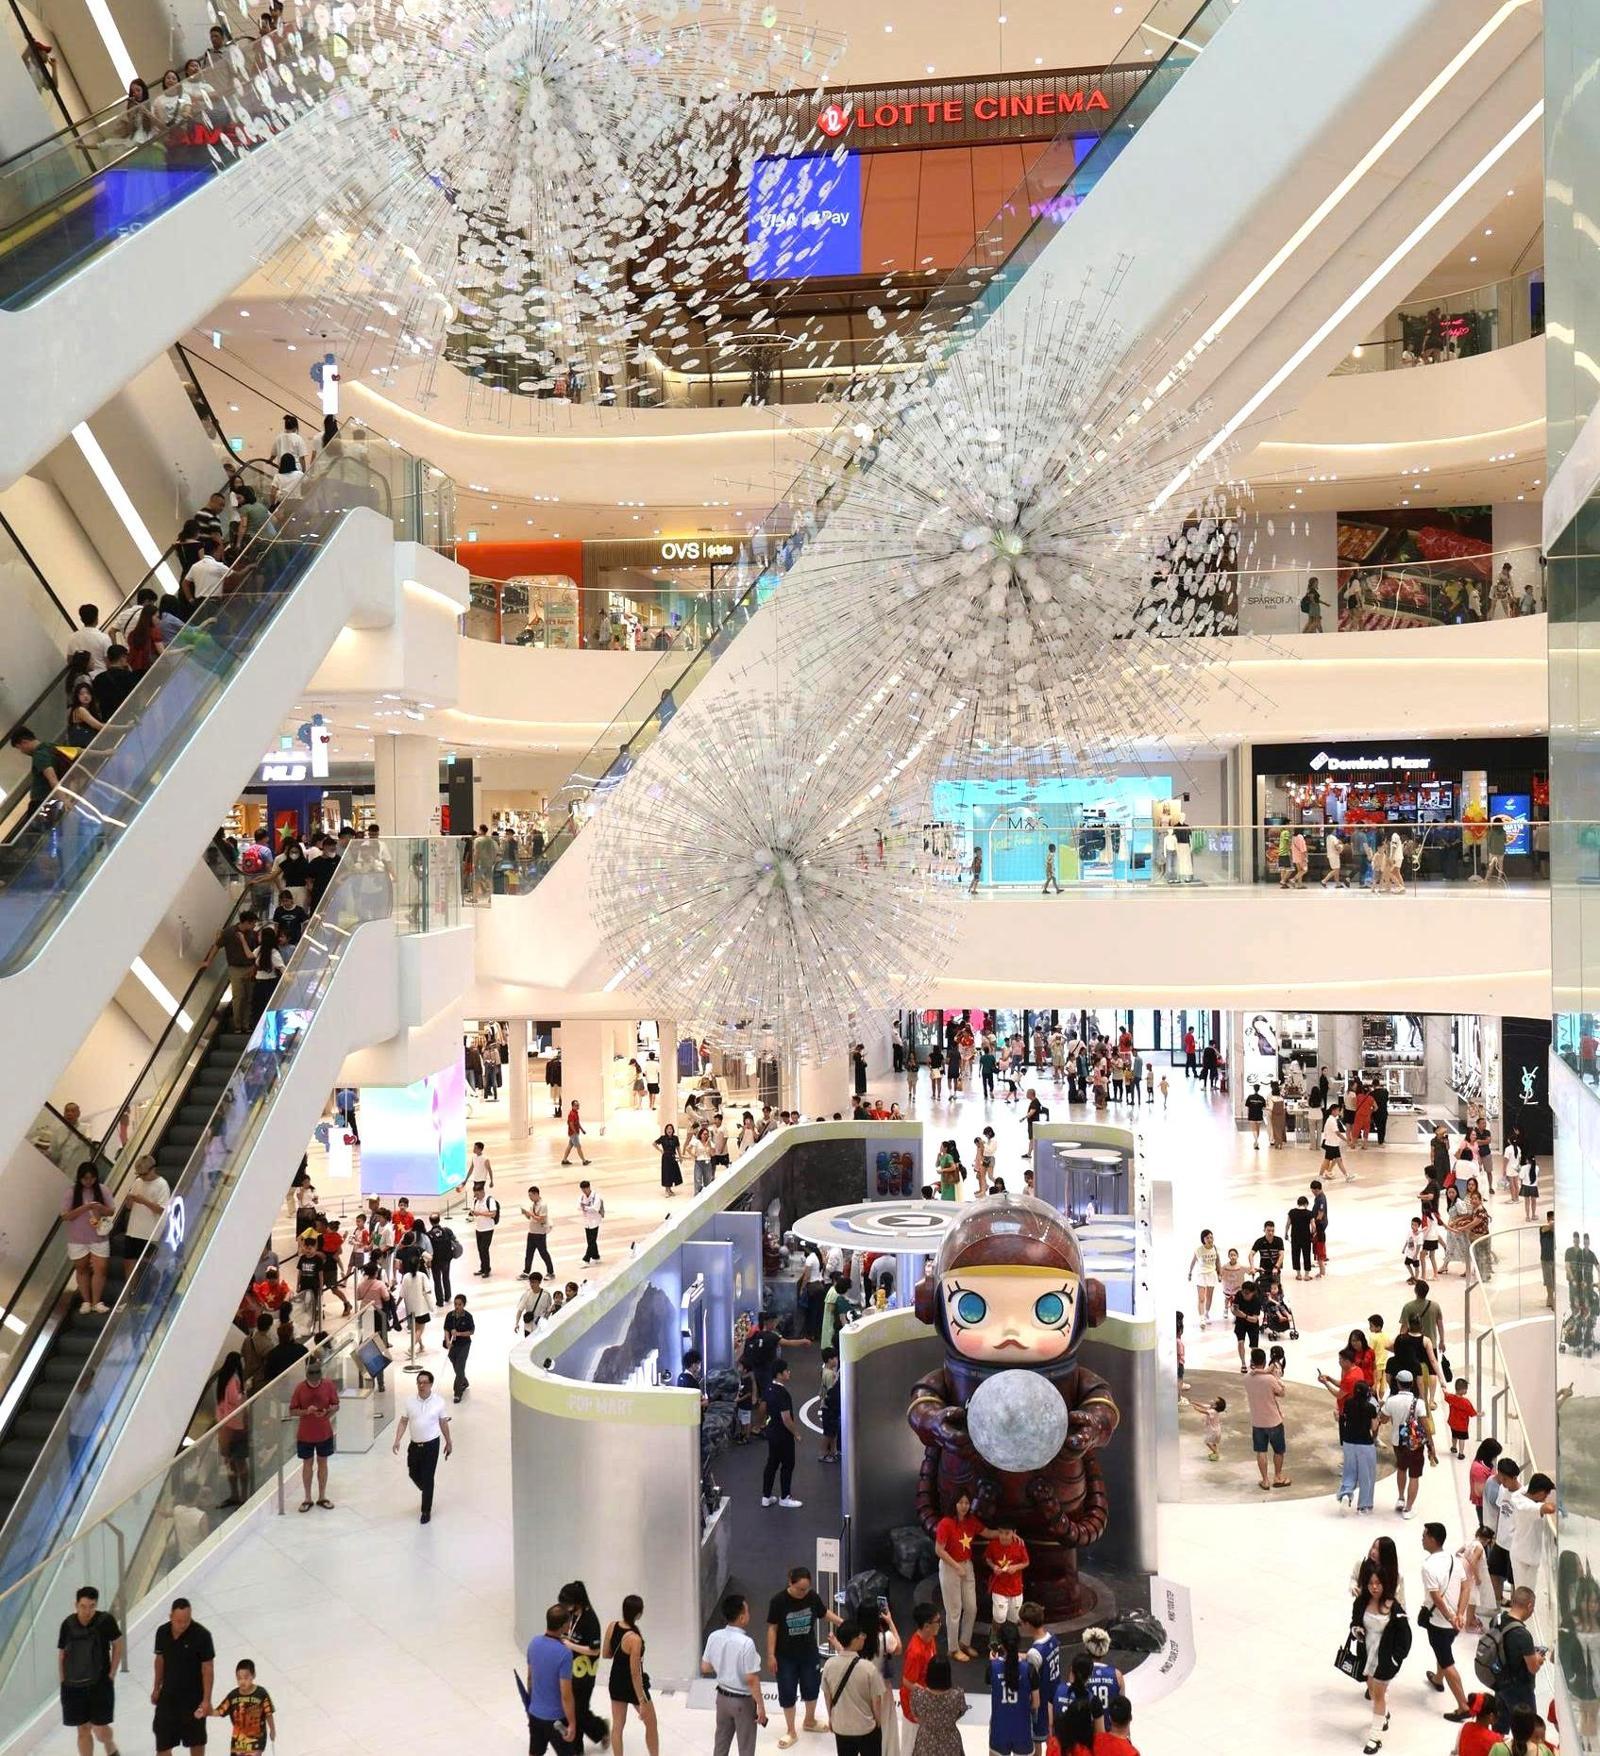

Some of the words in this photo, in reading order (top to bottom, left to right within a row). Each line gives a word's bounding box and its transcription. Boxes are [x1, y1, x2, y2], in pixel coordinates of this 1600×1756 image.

[856, 100, 963, 128] LOTTE
[973, 89, 1109, 120] CINEMA
[822, 210, 849, 226] Pay
[661, 542, 700, 560] OVS
